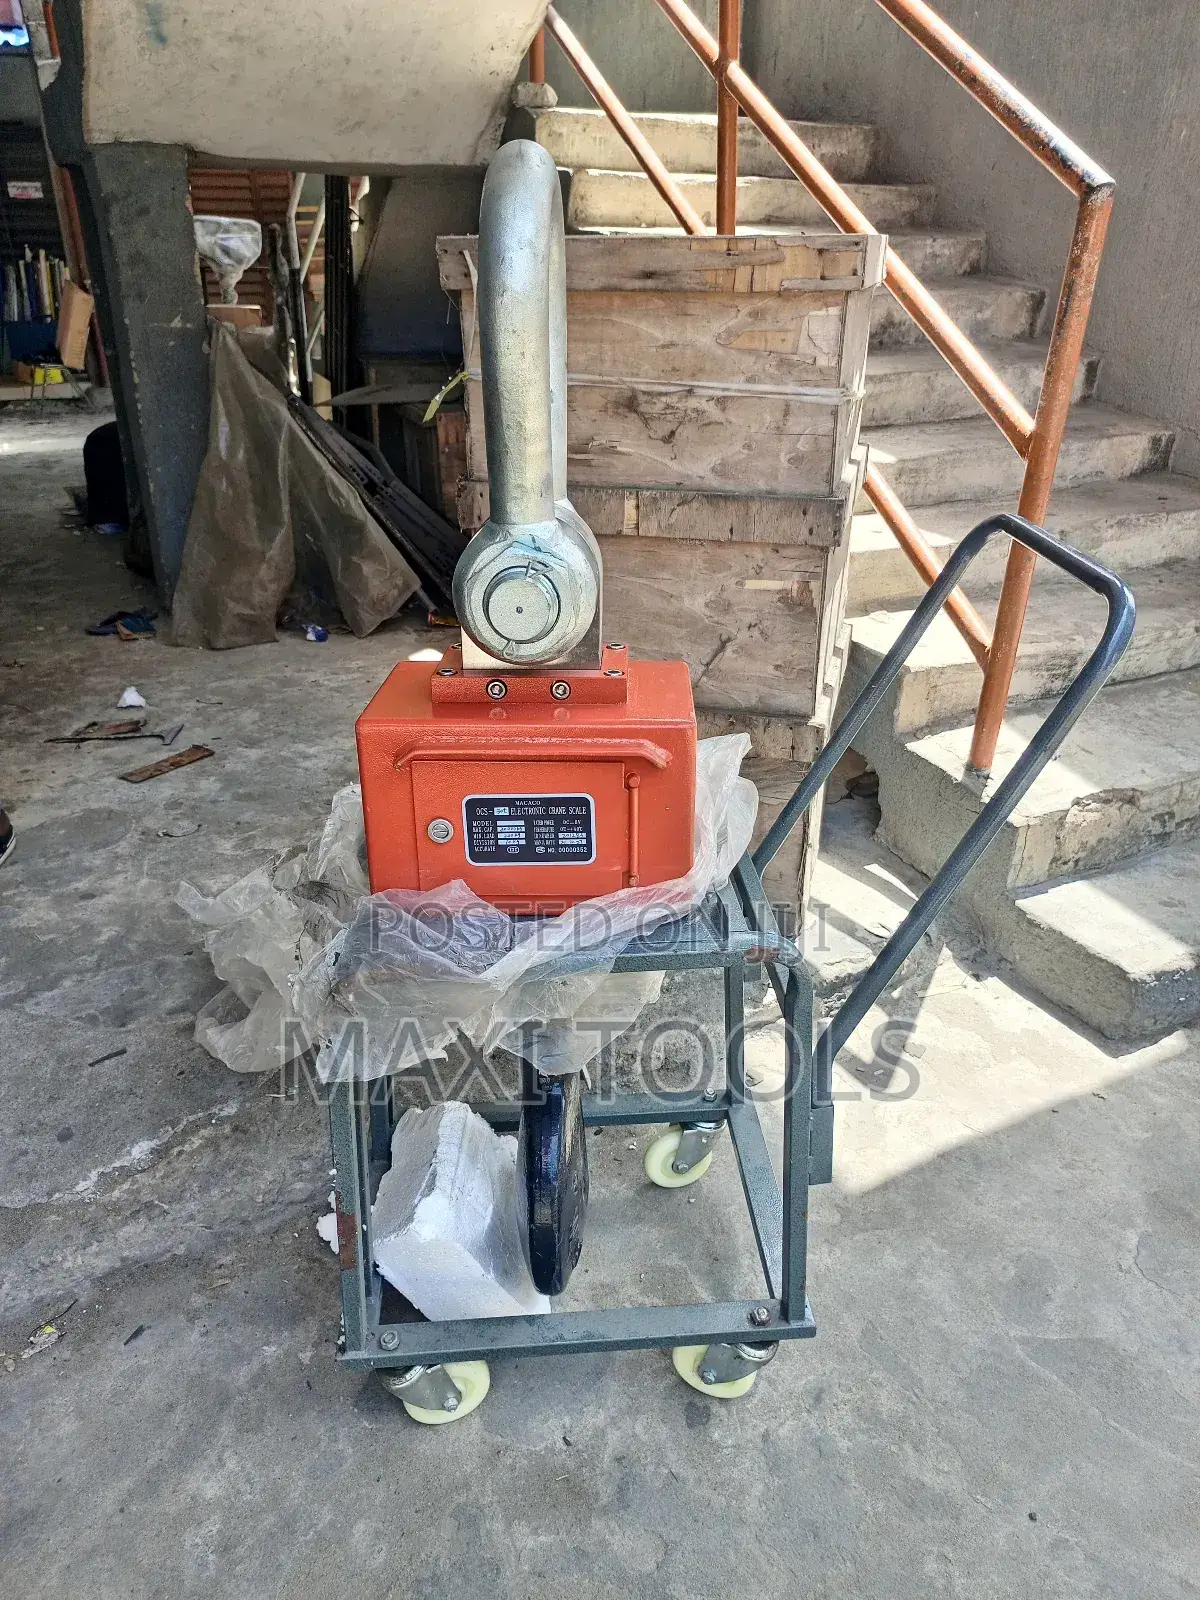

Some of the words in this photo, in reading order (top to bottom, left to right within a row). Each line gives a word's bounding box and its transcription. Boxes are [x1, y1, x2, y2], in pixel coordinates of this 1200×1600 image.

[510, 807, 547, 816] ELECTRONIC
[548, 806, 567, 815] CRANE
[568, 806, 587, 815] SCALE
